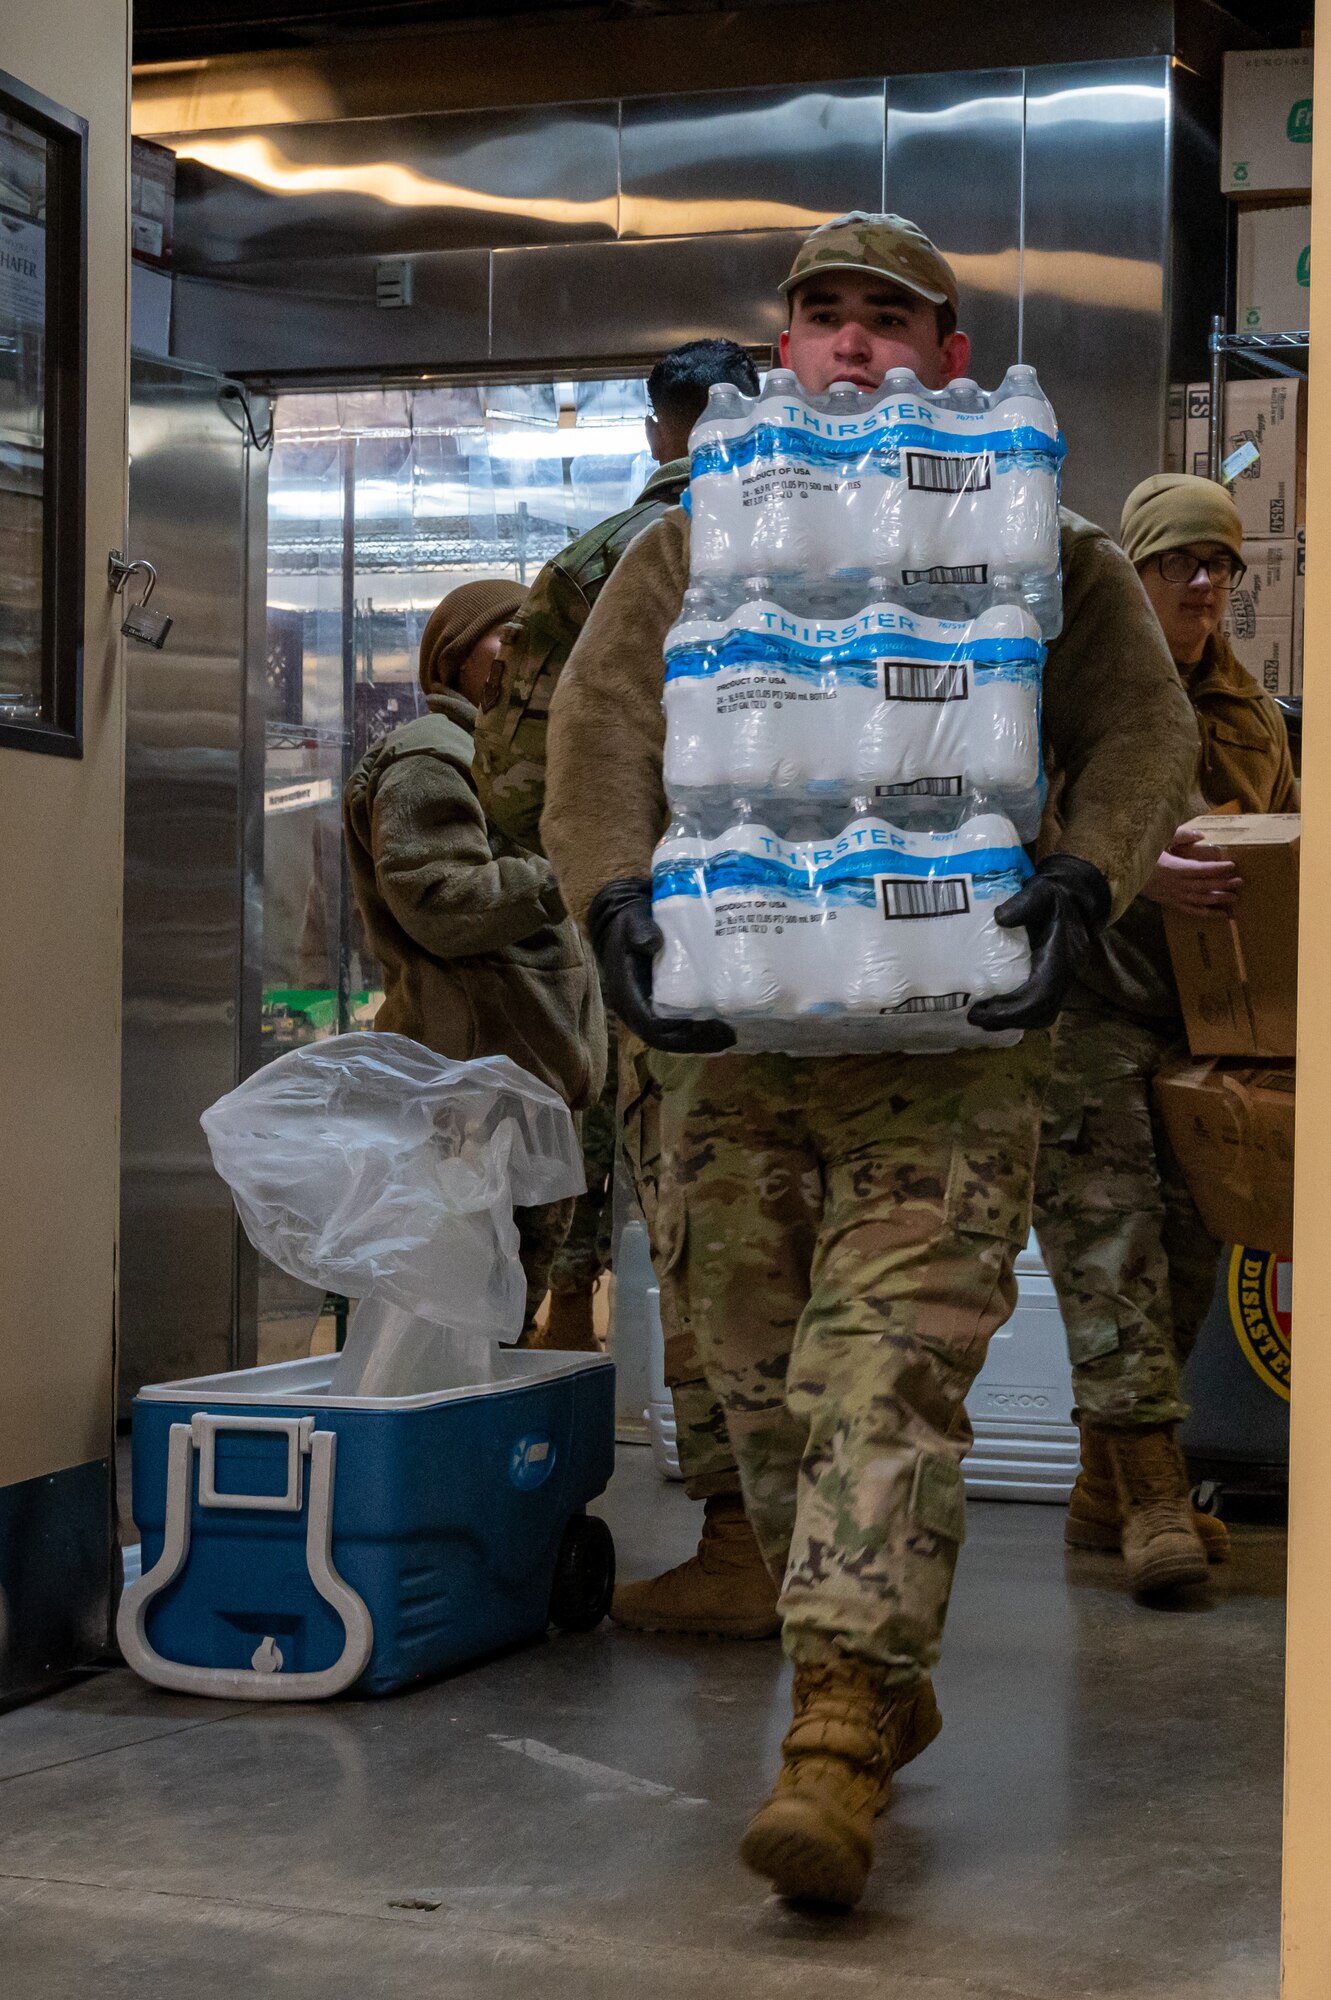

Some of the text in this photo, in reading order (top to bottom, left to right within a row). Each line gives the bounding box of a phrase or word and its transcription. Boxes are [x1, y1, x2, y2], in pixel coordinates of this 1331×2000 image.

[783, 403, 934, 437] THIRSTER
[742, 467, 811, 486] PRODUCT OF USA
[809, 482, 822, 491] 500
[1271, 500, 1283, 532] 26547
[760, 612, 916, 643] THIRSTER
[1230, 593, 1247, 637] TREATS
[716, 676, 787, 691] PRODUCT OF USA
[1265, 661, 1277, 692] 26547
[714, 901, 753, 913] PRODUCT
[754, 900, 766, 908] OF
